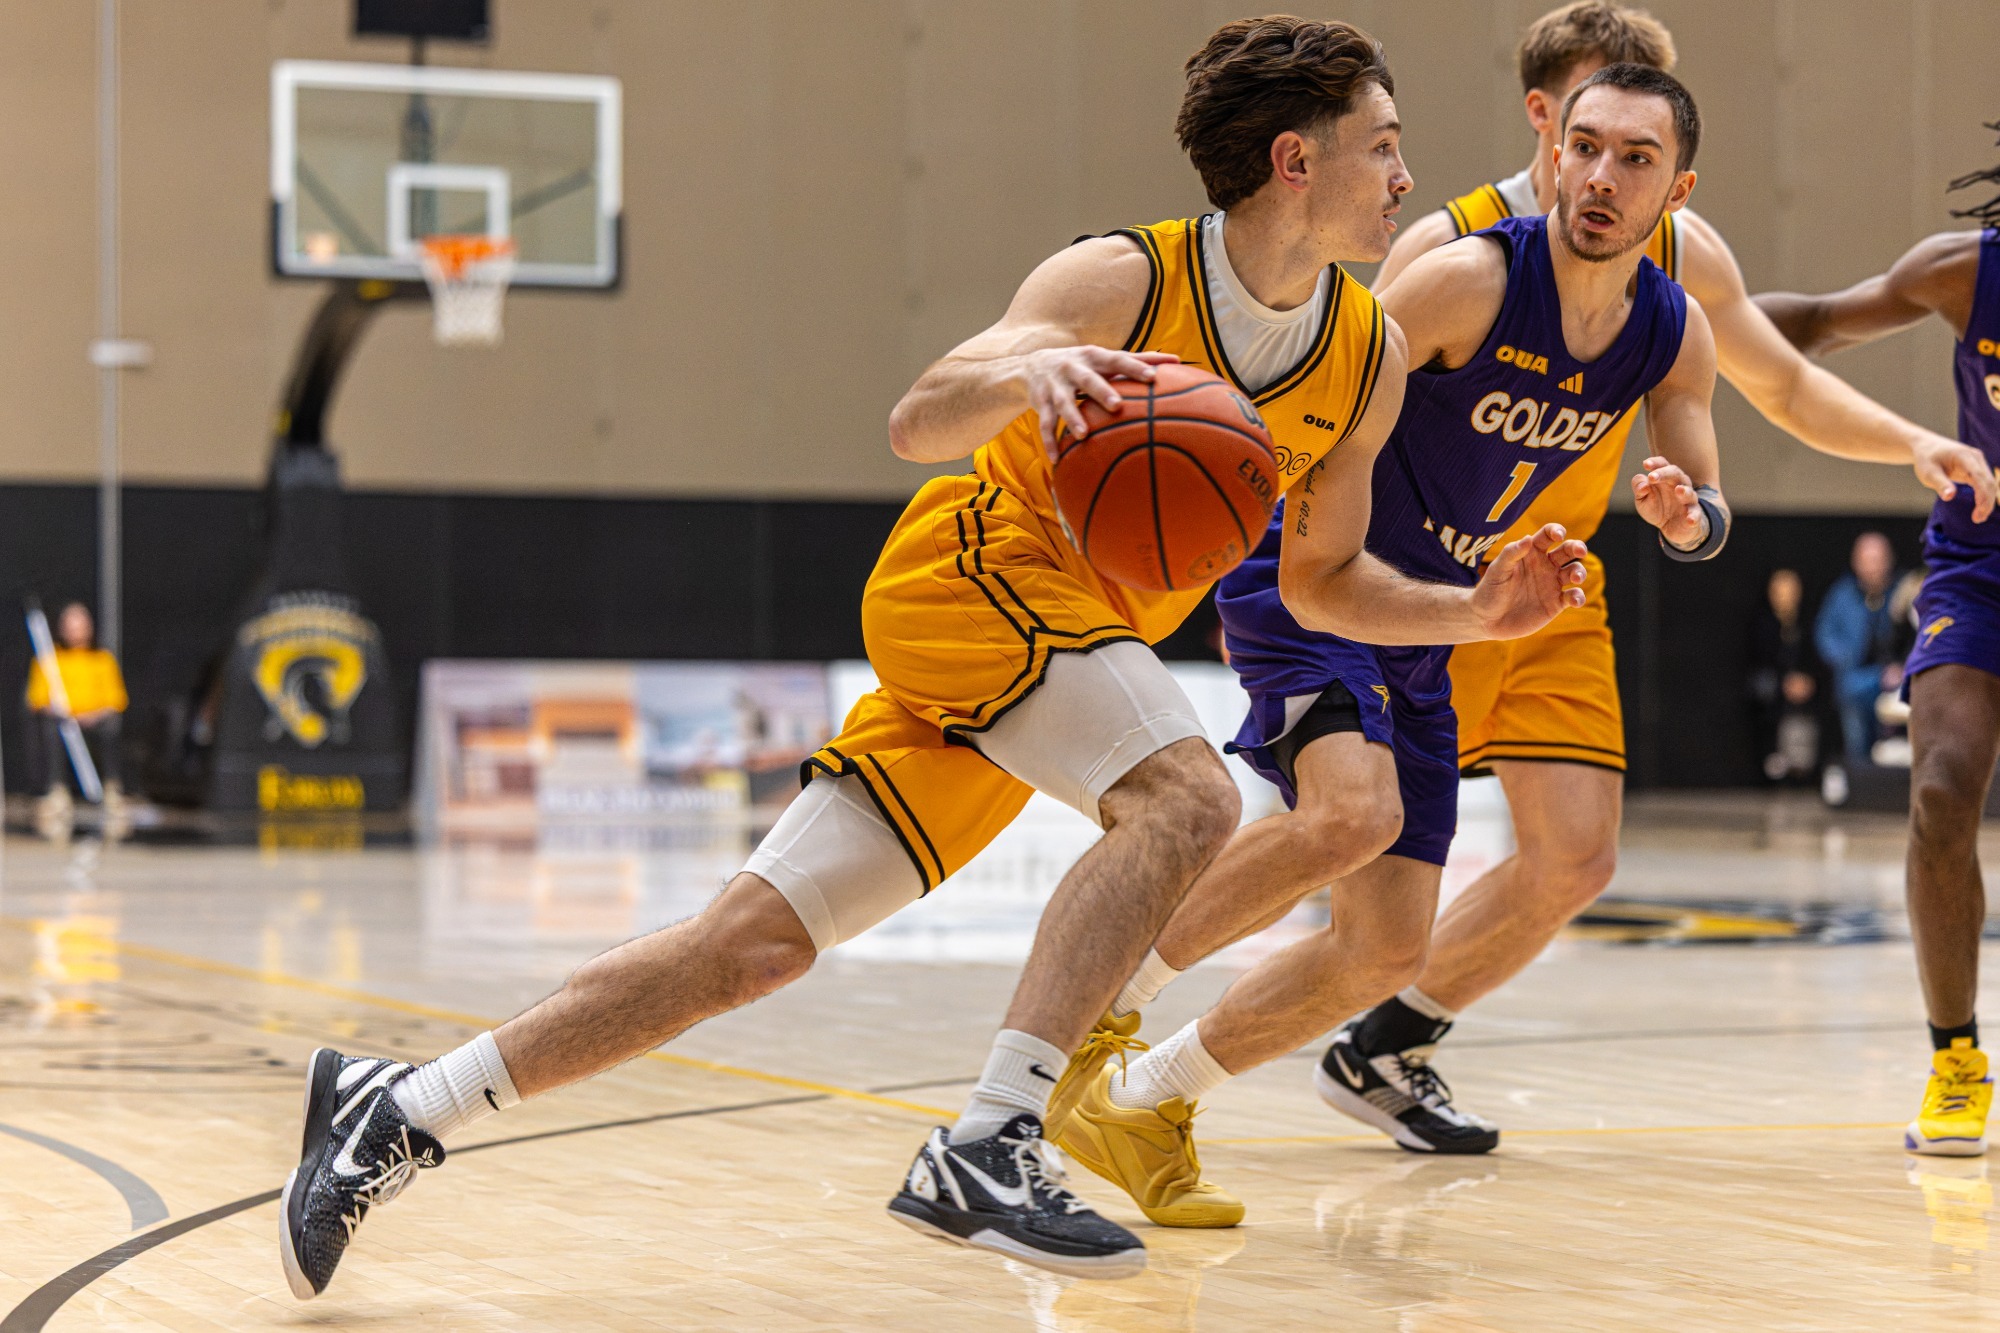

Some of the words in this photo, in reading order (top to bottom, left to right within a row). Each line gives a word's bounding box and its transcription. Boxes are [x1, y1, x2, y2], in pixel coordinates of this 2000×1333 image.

[1496, 345, 1548, 375] OUA
[1303, 414, 1335, 432] OUA
[1485, 461, 1538, 522] 1
[1296, 500, 1310, 537] 60:22
